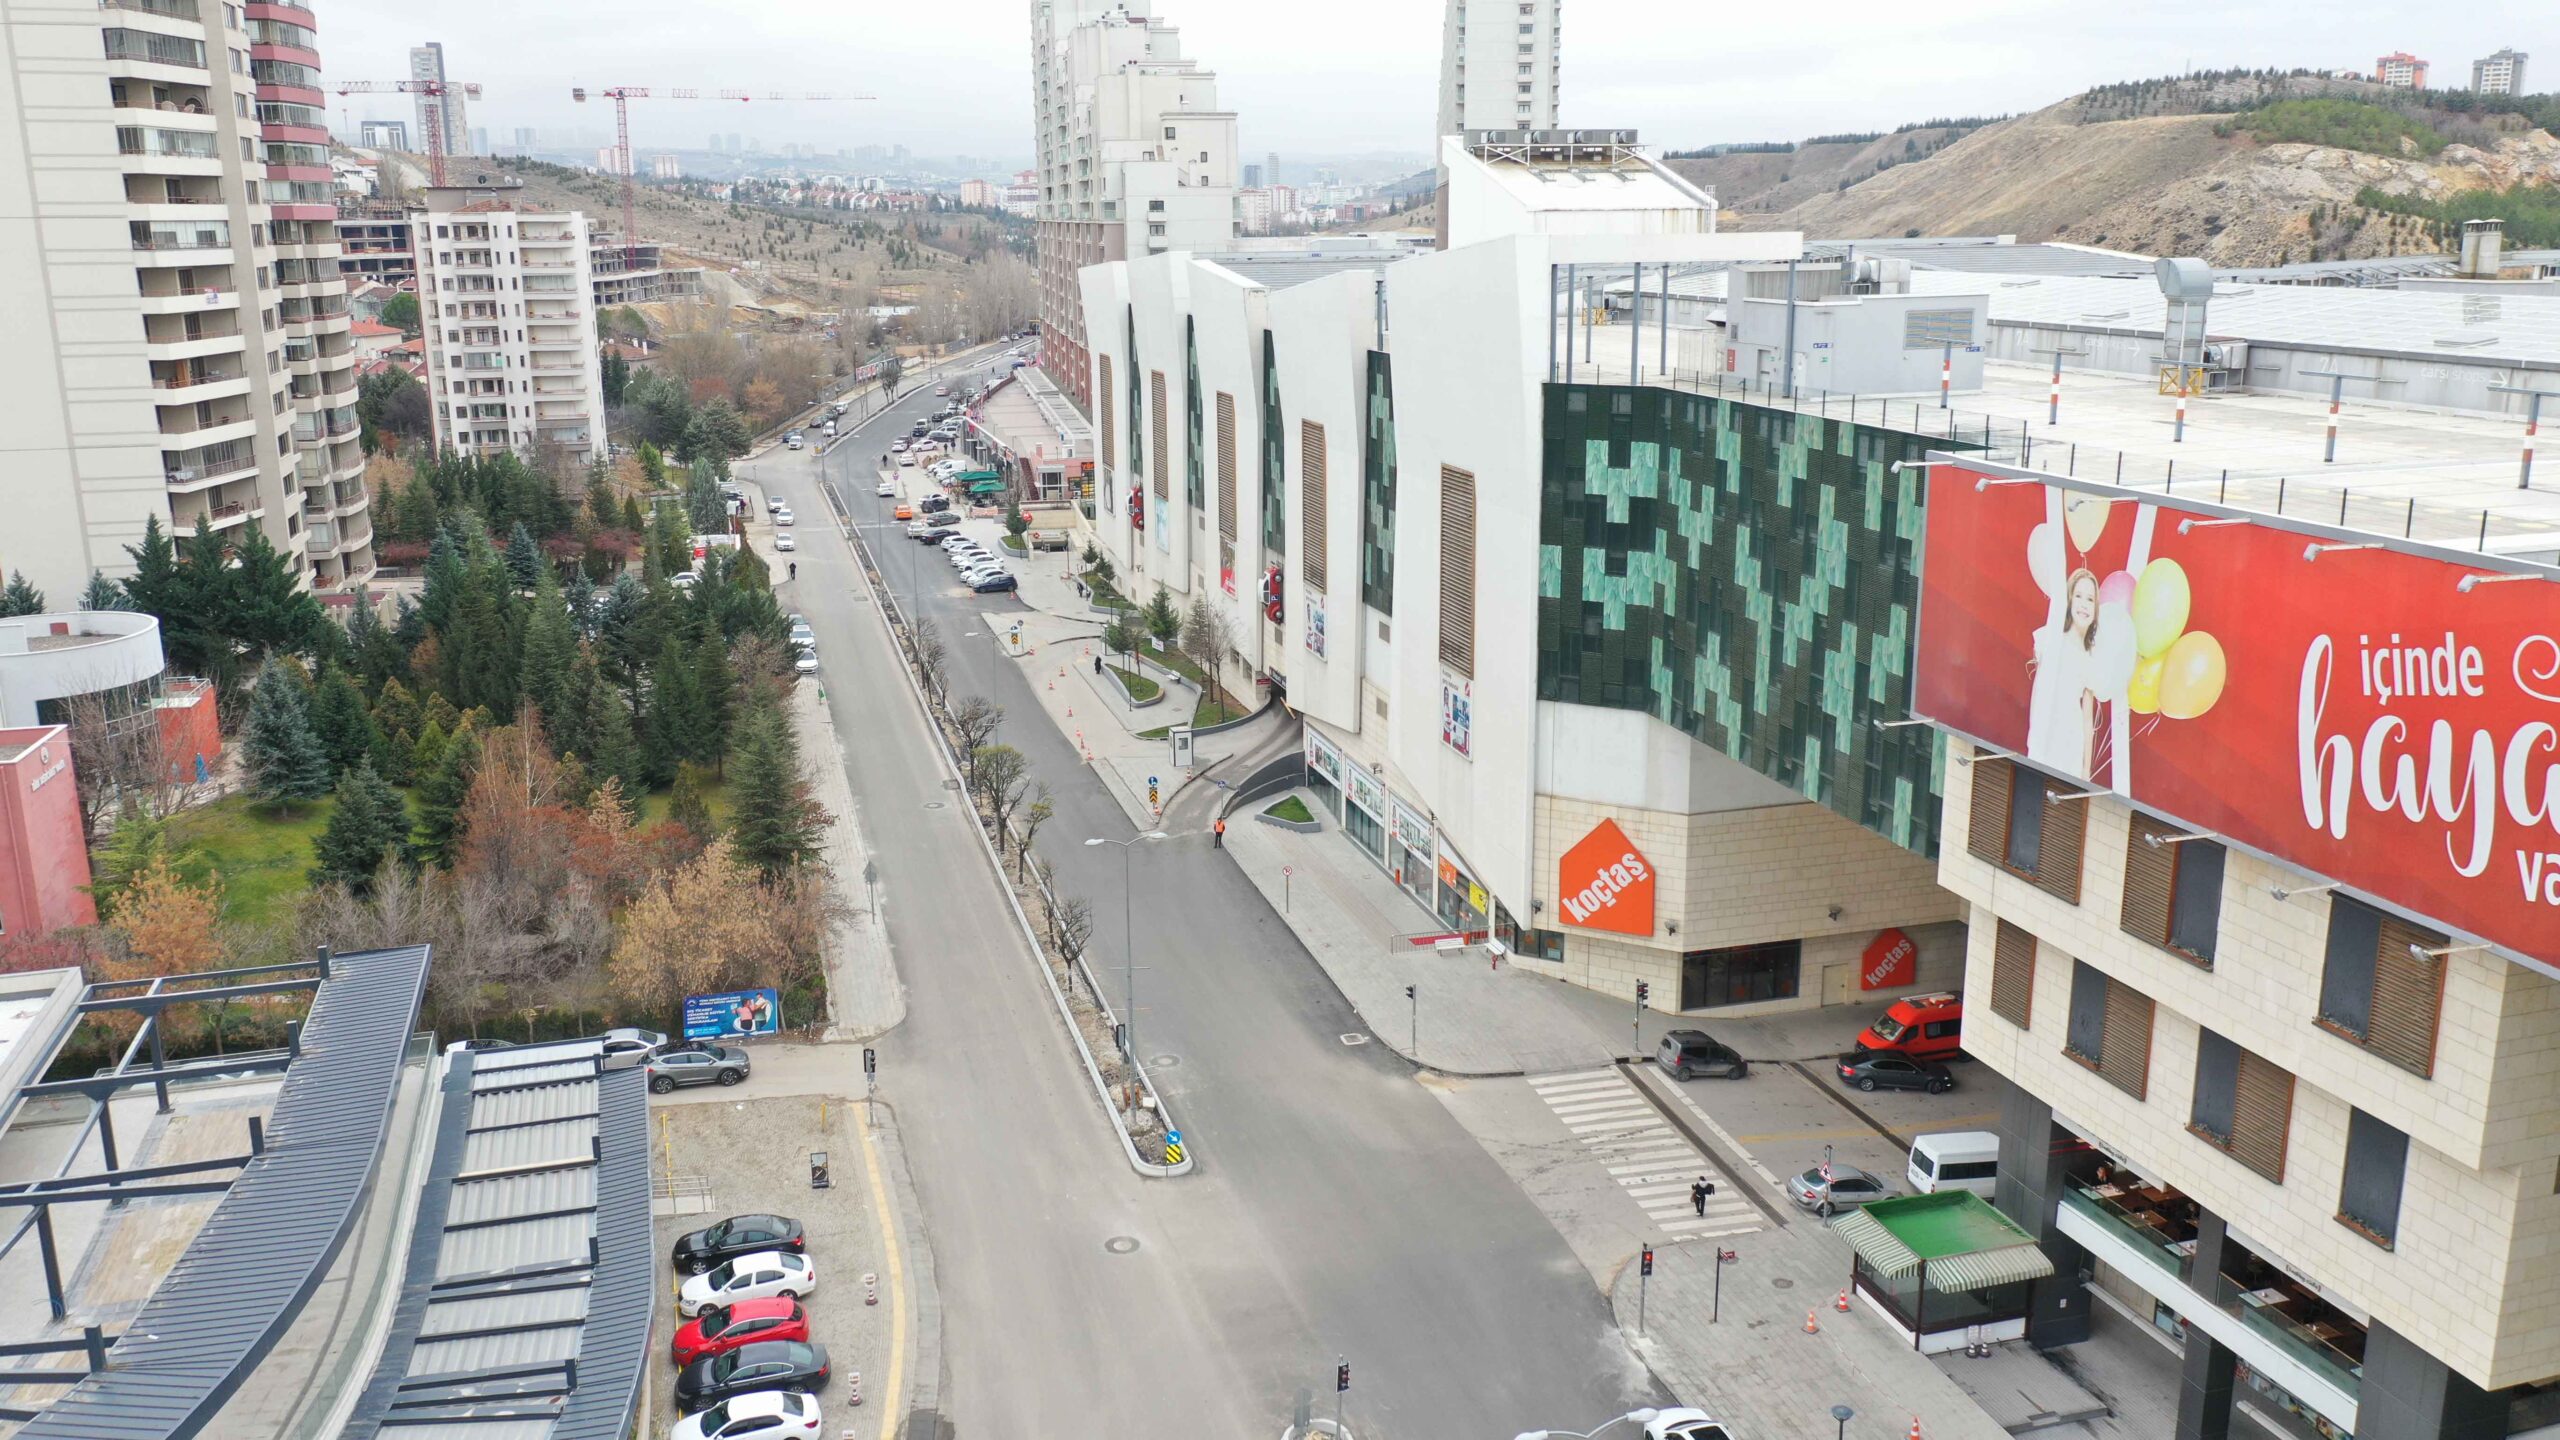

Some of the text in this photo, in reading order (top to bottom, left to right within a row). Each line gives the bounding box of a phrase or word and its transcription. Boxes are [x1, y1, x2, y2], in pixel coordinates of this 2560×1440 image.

[2360, 632, 2485, 706] içinde
[1562, 853, 1649, 923] koçtaş
[1865, 939, 1913, 986] koçtaş
